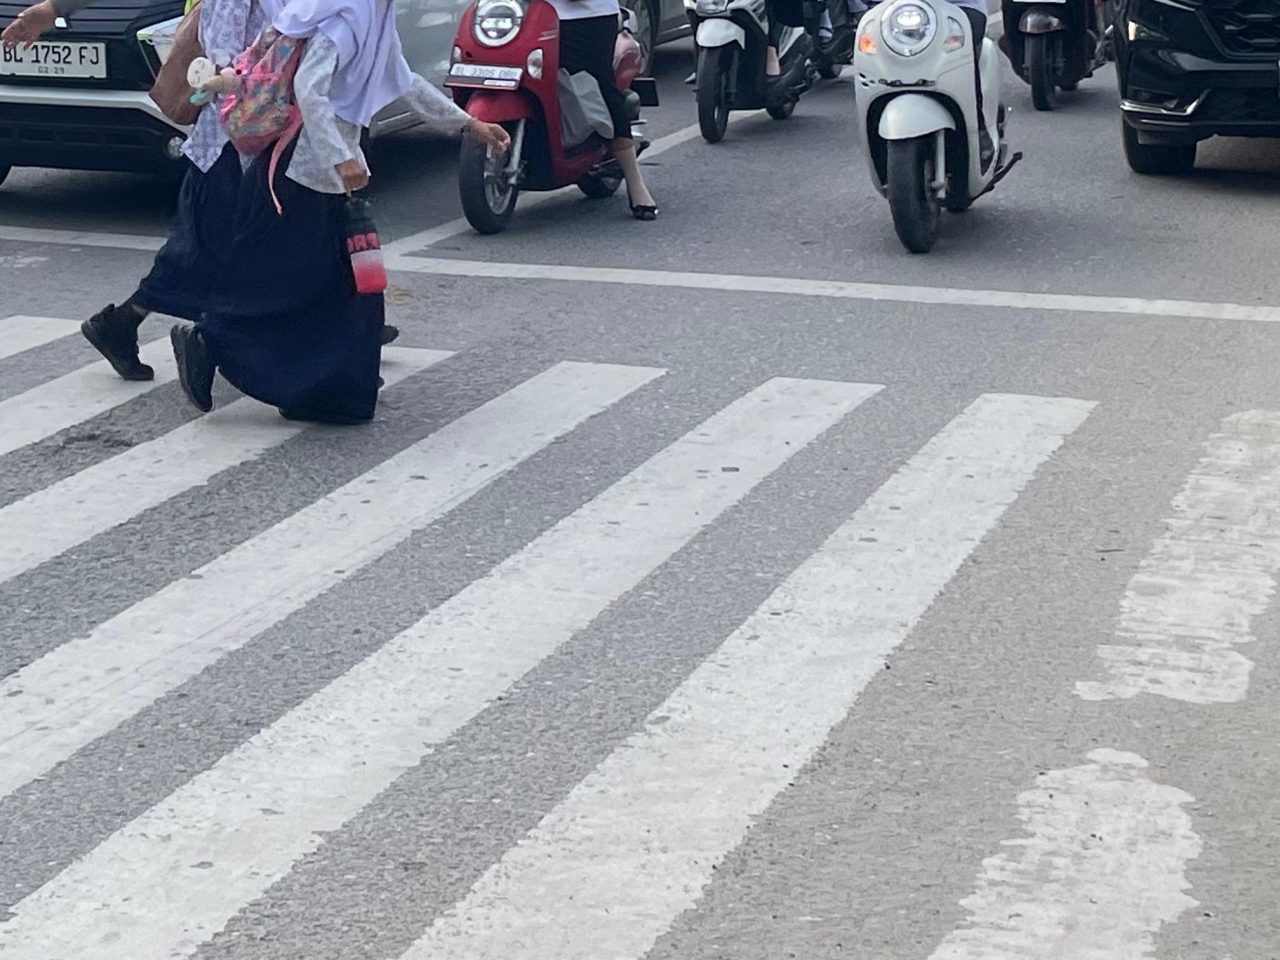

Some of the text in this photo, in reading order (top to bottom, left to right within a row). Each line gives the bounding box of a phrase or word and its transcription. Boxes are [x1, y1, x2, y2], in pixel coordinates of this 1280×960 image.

[3, 44, 100, 65] BL 1752 FJ
